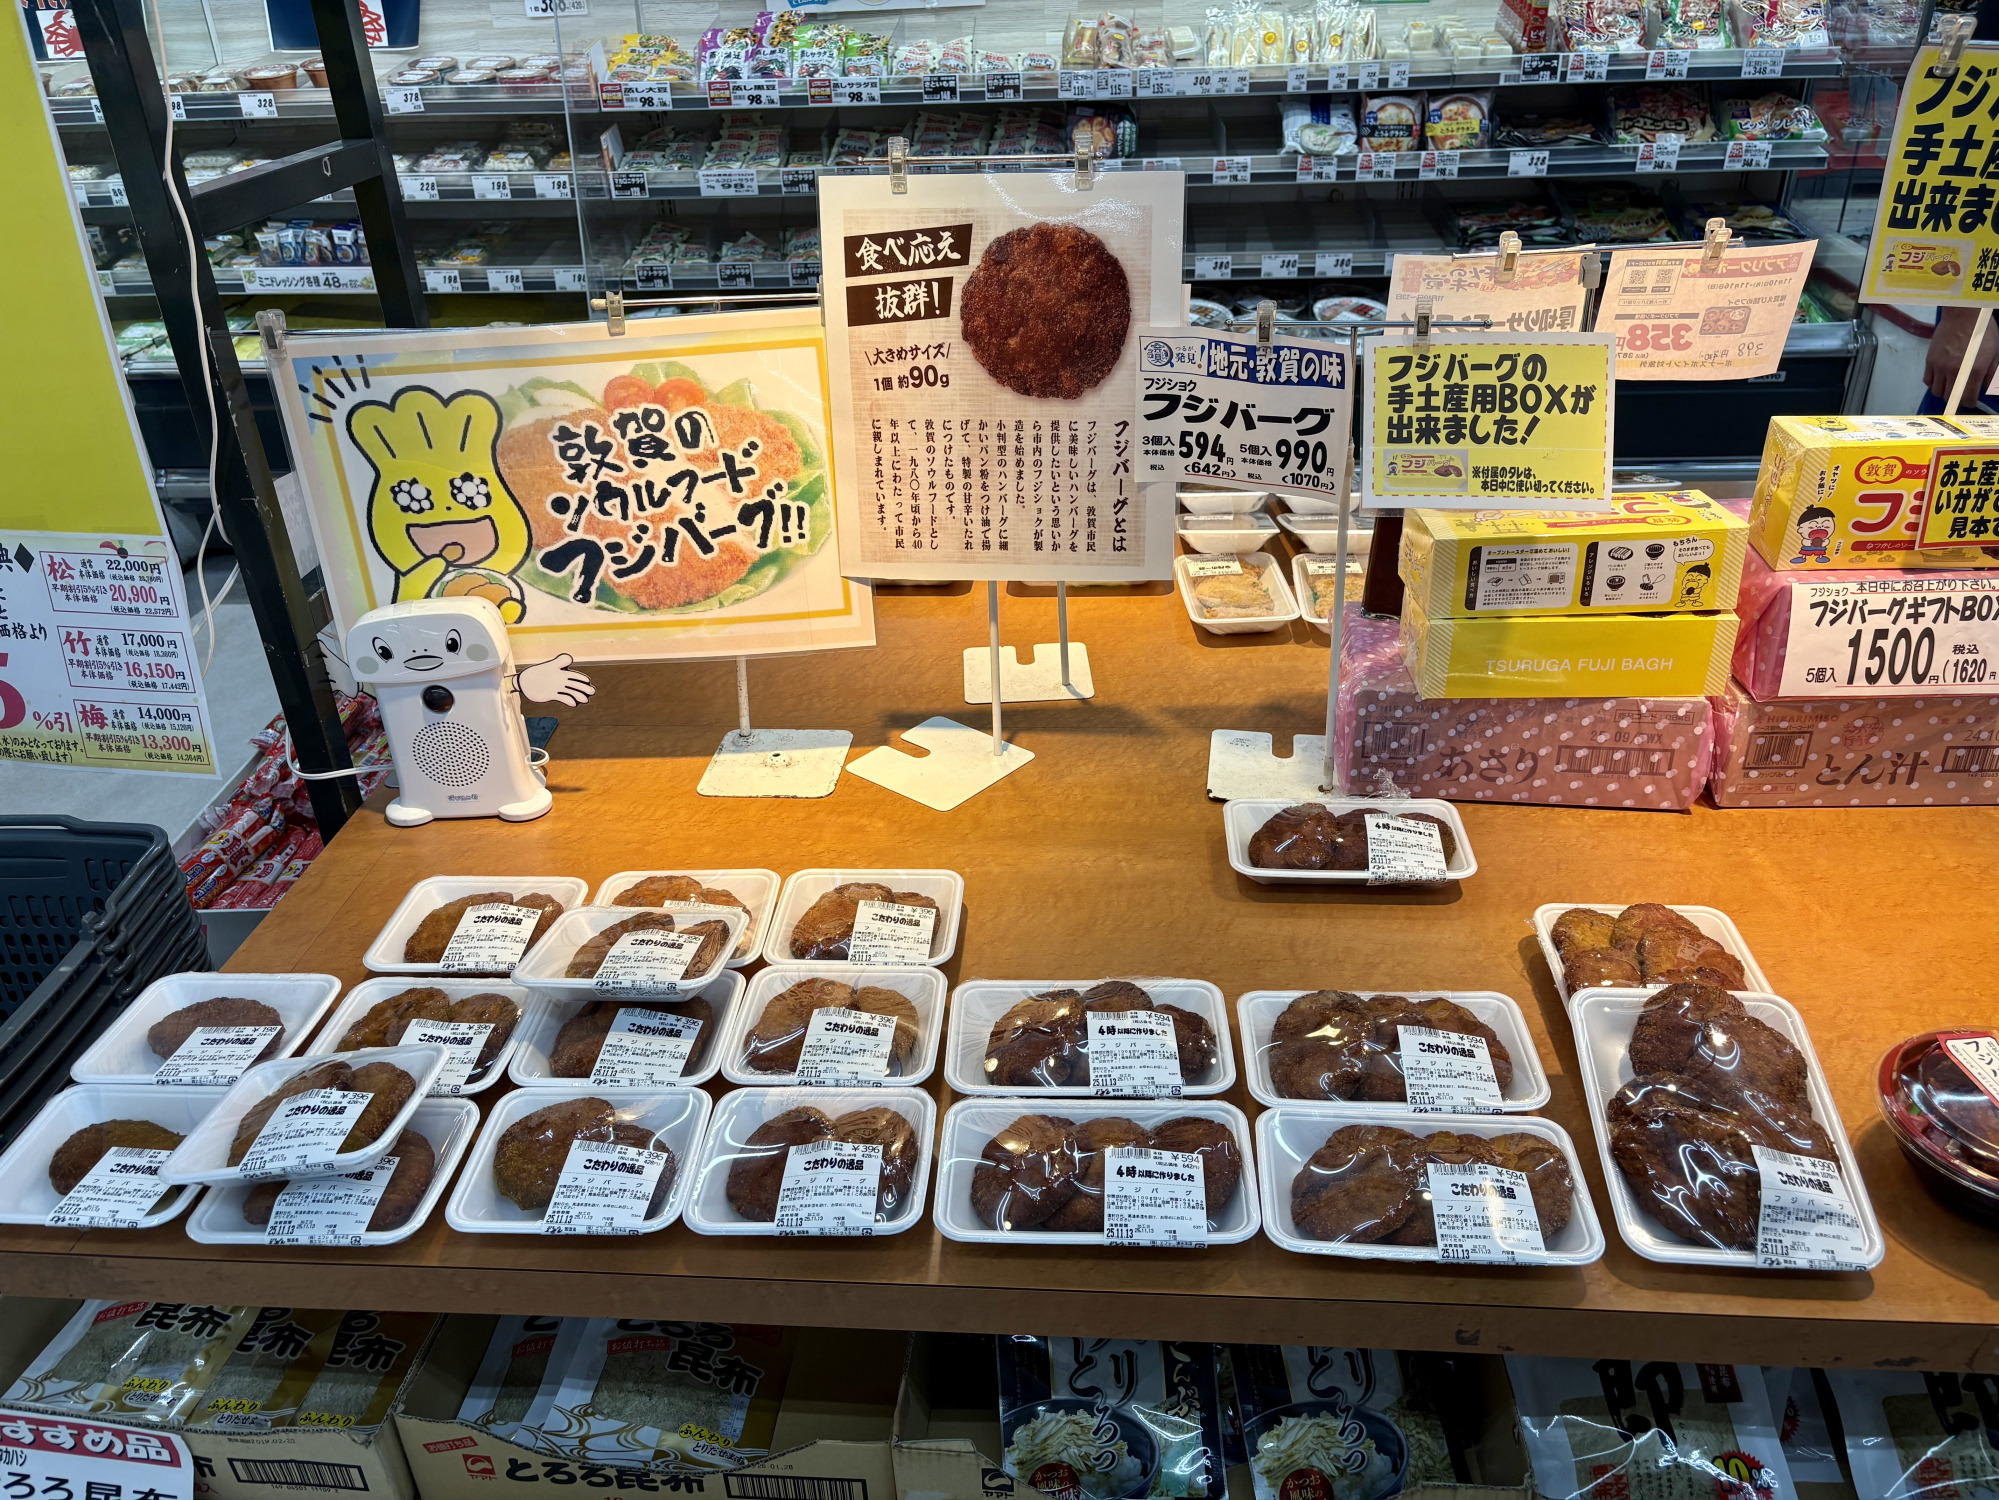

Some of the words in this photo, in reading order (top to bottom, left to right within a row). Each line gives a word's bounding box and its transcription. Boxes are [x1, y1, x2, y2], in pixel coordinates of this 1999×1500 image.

[1193, 76, 1211, 85] 300
[403, 92, 419, 102] 378
[747, 94, 762, 105] 98
[848, 91, 863, 102] 98
[1915, 64, 1999, 121] フジ
[257, 98, 273, 108] 328
[639, 96, 655, 108] 98
[420, 182, 436, 191] 228
[491, 181, 507, 190] 198
[551, 181, 567, 189] 198
[855, 230, 962, 272] 食べ応え
[1213, 261, 1230, 270] 380
[1280, 259, 1297, 268] 380
[1333, 258, 1351, 267] 380
[443, 275, 458, 284] 198
[505, 274, 520, 283] 198
[874, 280, 942, 320] 抜群!
[1387, 352, 1548, 383] フジバーグの
[1143, 377, 1198, 393] フジショク
[1387, 382, 1597, 416] 手土産用BOXが
[1142, 393, 1336, 437] フジバーグ
[1386, 414, 1541, 446] 出来ました!
[557, 408, 716, 484] 敦賀の
[1142, 435, 1175, 447] 3個入
[1239, 443, 1273, 457] 5個入
[942, 418, 957, 520] につけたものです。
[1014, 419, 1026, 511] 造を始めました。
[1865, 462, 1898, 478] 敦賀
[871, 418, 888, 533] に親しまれています。
[1939, 459, 1999, 488] お土産
[550, 440, 760, 534] ソウルフード
[1112, 419, 1131, 552] フジバーグとは
[1480, 478, 1595, 495] 本日中に使い切ってください。
[1672, 536, 1698, 547] もちろん
[46, 554, 76, 582] 松
[105, 559, 162, 576] 22,000円
[1810, 587, 1850, 598] フジショク
[62, 630, 92, 657] 竹
[121, 632, 178, 650] 17,000円
[1951, 643, 1980, 655] 税込
[1485, 657, 1572, 673] TSURUGA
[1577, 658, 1617, 673] FUJI
[1621, 657, 1674, 672] BAGH
[1805, 667, 1837, 683] 5個入
[78, 703, 109, 731] 梅
[137, 706, 192, 723] 14,000円
[1434, 745, 1540, 786] あさり
[1815, 751, 1930, 786] とん汁
[122, 1375, 173, 1392] ふんわり
[207, 1398, 263, 1414] ふんわり
[0, 1419, 174, 1462] すすめ品
[679, 1423, 736, 1449] ふんわり
